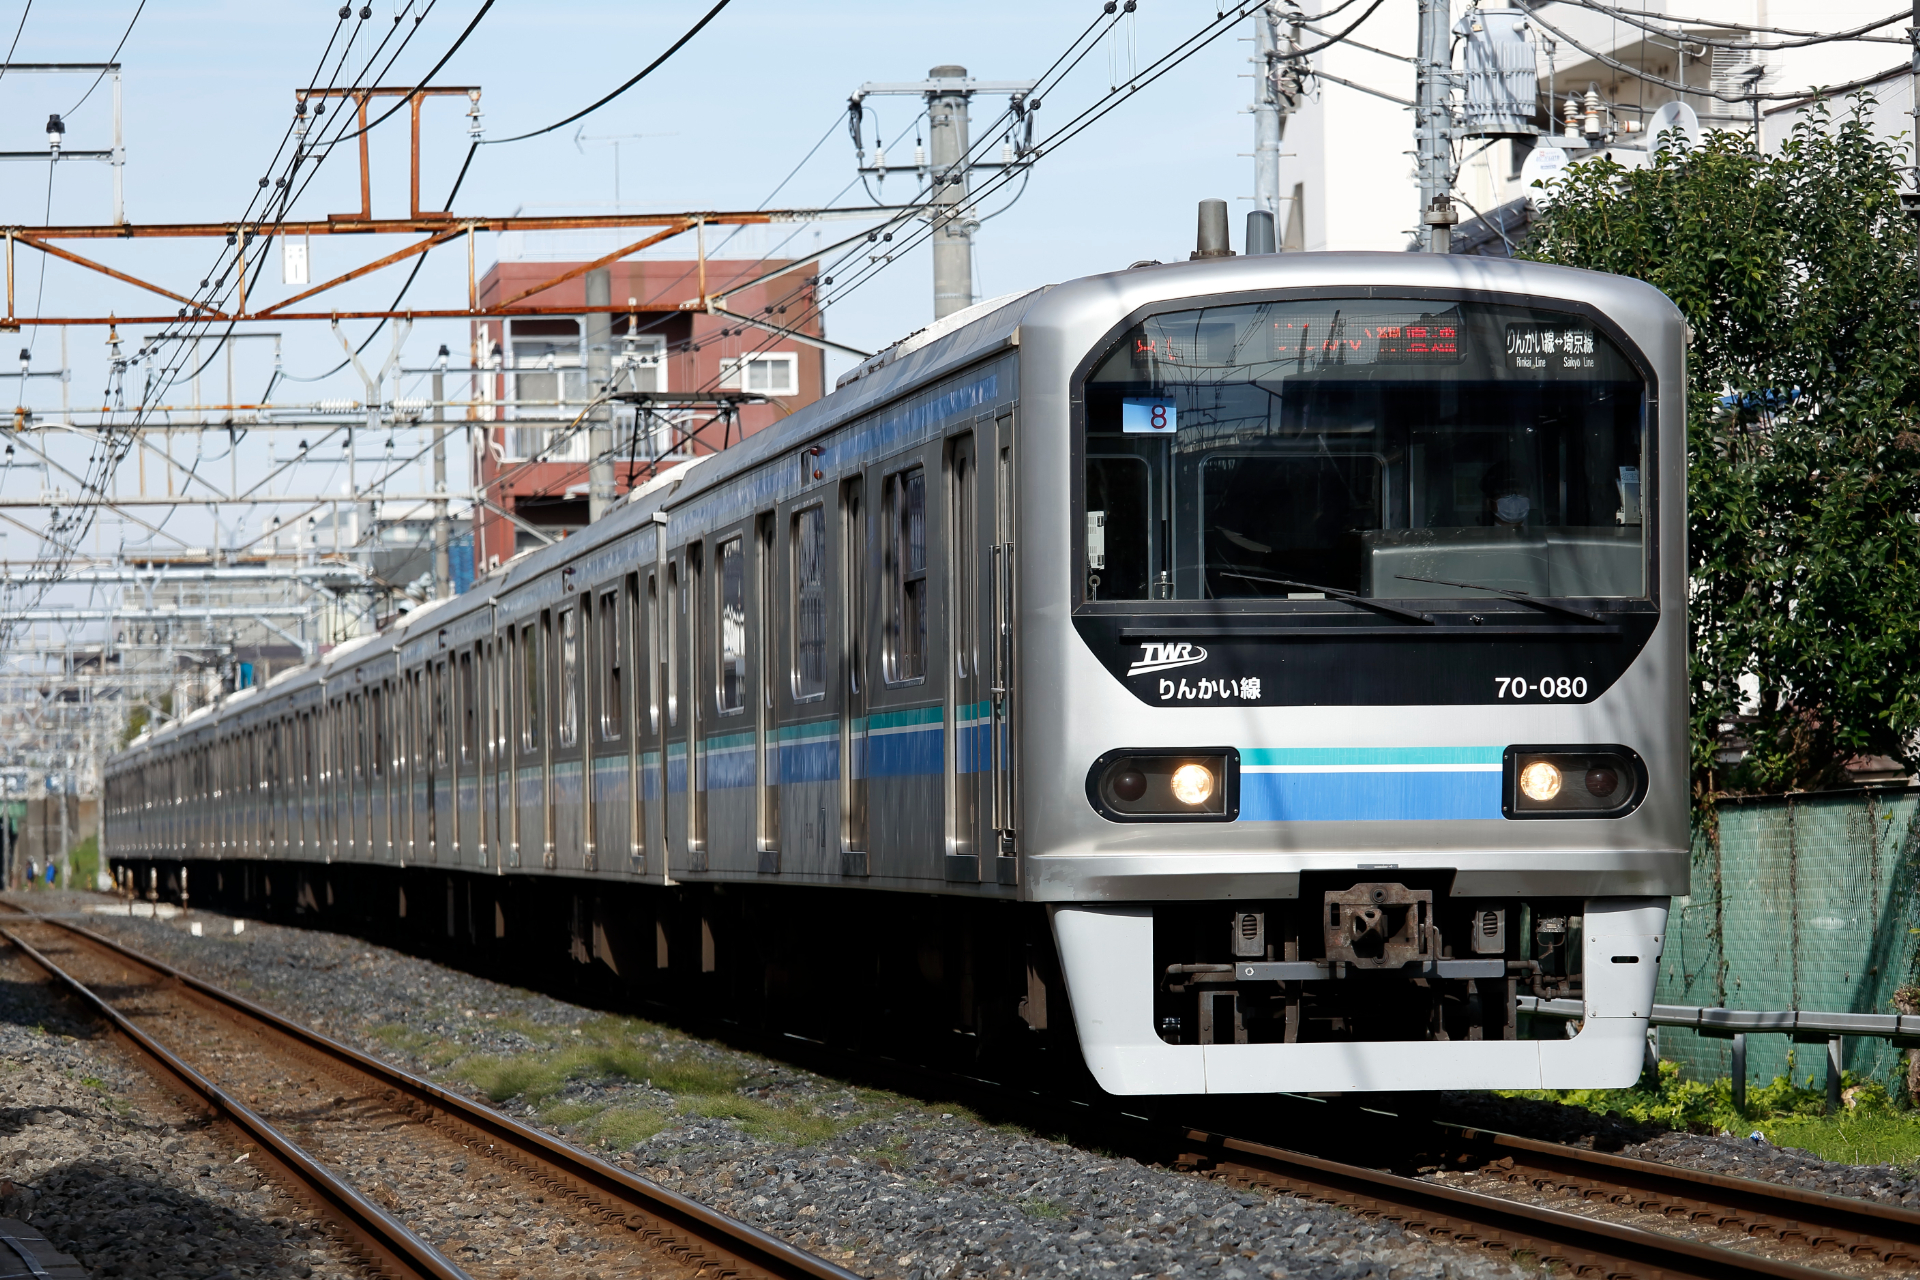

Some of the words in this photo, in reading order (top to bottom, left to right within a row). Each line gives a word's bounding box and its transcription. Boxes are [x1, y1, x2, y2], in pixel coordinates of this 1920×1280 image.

[1507, 329, 1555, 354] りんかい線
[1563, 329, 1594, 354] 埼京線
[1516, 356, 1532, 367] Rinkai
[1535, 356, 1546, 367] Line
[1563, 356, 1580, 369] Saikyo
[1583, 356, 1594, 367] Line
[1150, 404, 1167, 429] 8
[1159, 676, 1262, 700] りんかい線
[1495, 677, 1588, 698] 70-080
